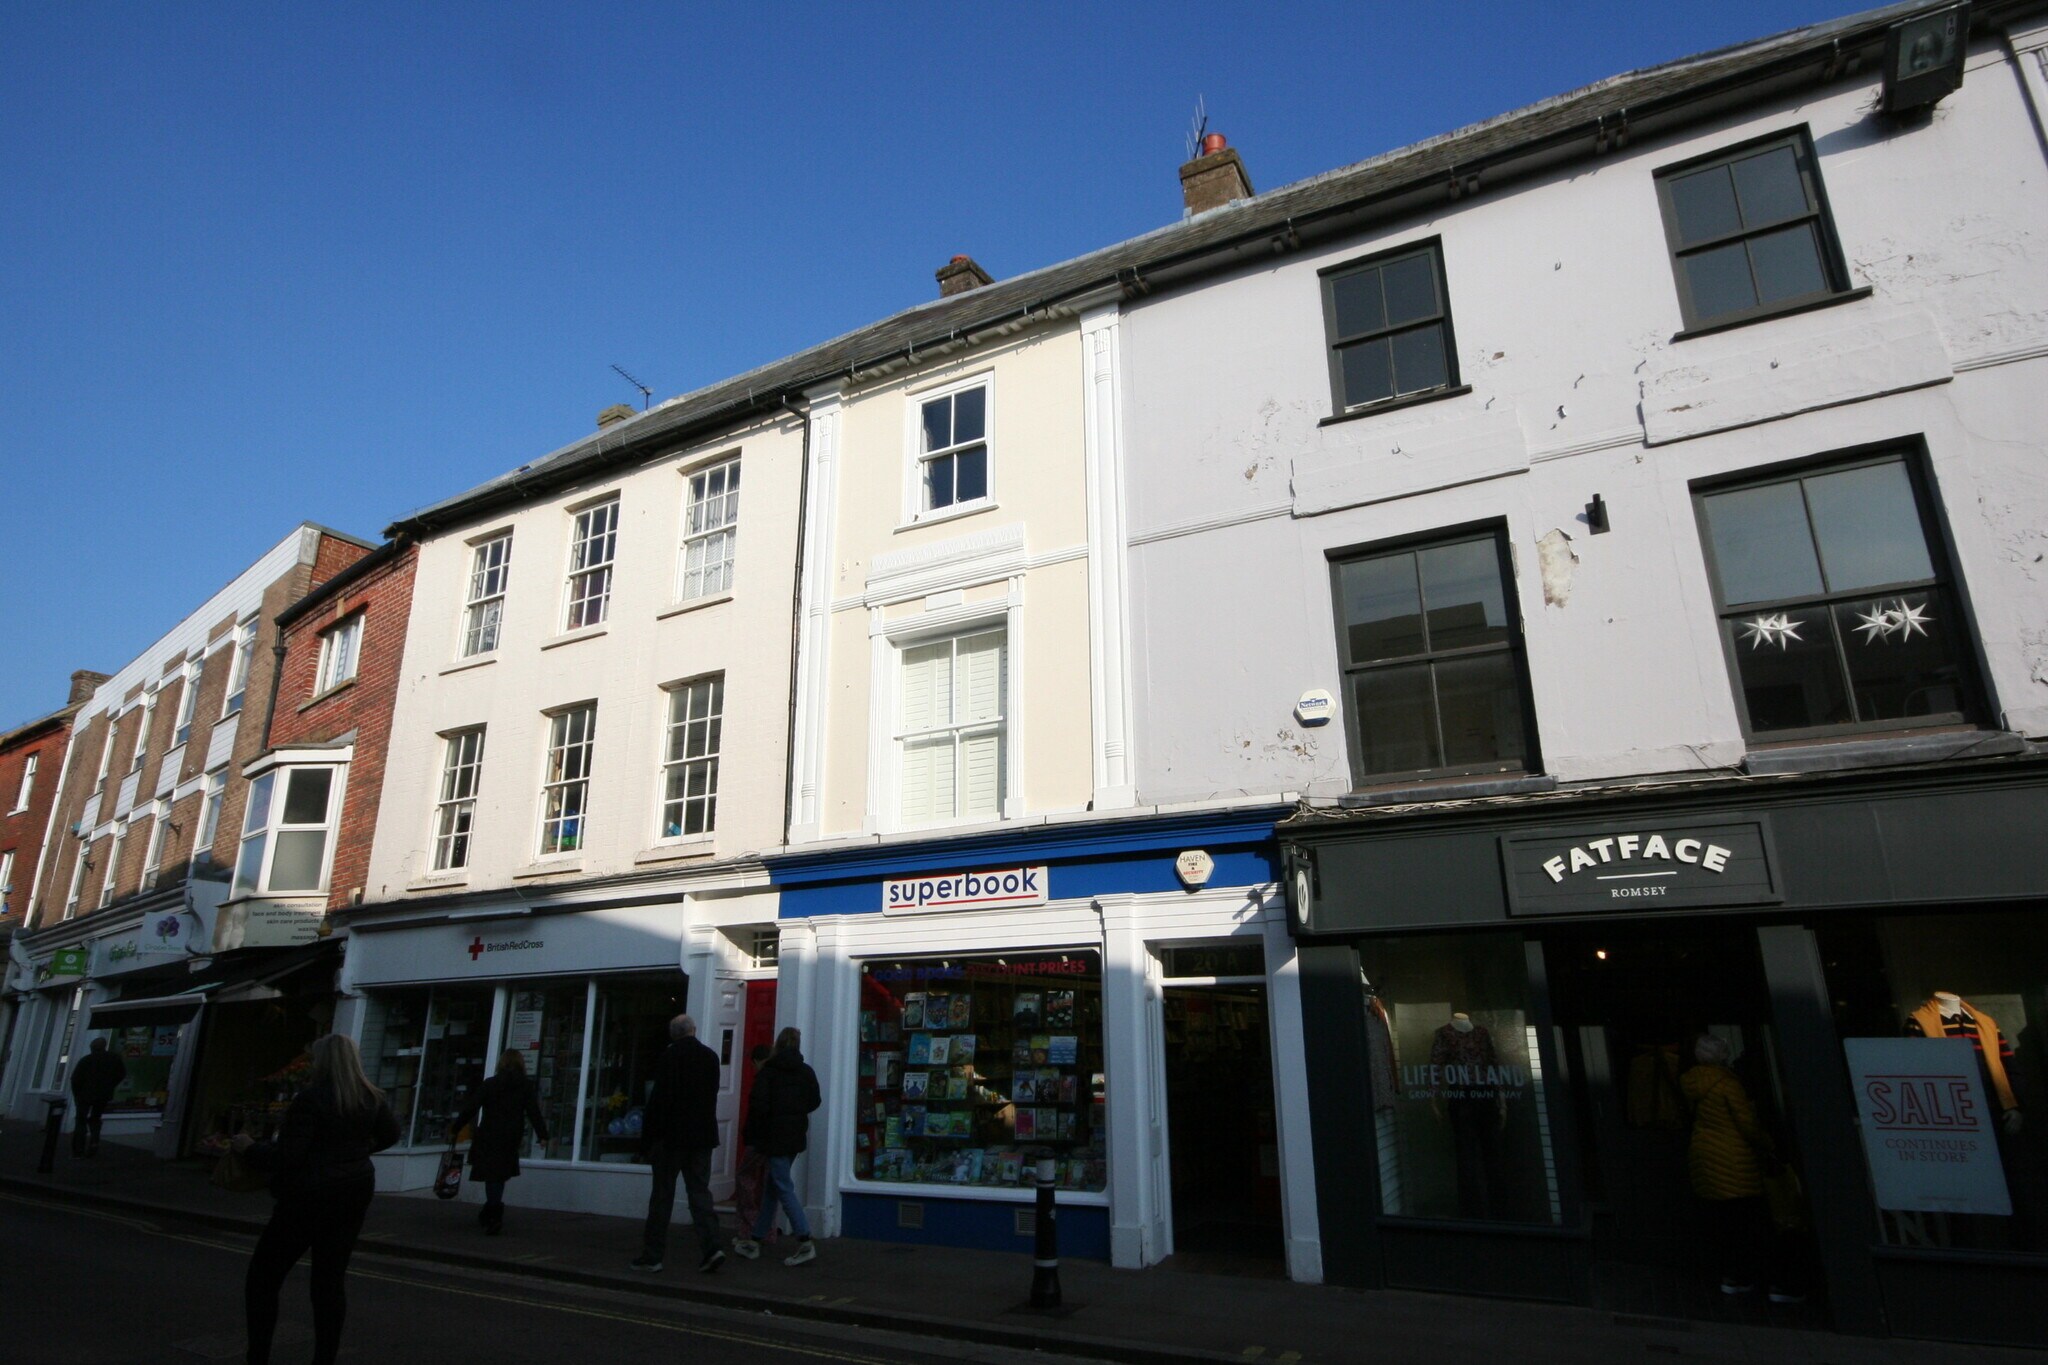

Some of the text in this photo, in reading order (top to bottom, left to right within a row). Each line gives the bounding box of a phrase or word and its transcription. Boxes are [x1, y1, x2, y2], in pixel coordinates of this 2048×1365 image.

[1180, 855, 1205, 863] HAVEN
[1542, 834, 1732, 883] FATFACE
[889, 868, 1038, 906] superbook
[1611, 886, 1667, 898] ROMSEY
[294, 918, 319, 926] products
[875, 959, 1088, 982] GOOD BOOKS DISCOUNT PRICES
[1403, 1063, 1525, 1088] LIFE ON LAND
[1408, 1089, 1523, 1100] GROW YOUR OWN WAY
[1867, 1081, 1978, 1126] SALE
[1885, 1138, 1978, 1151] CONTINUES
[1900, 1151, 1969, 1163] IN STORE
